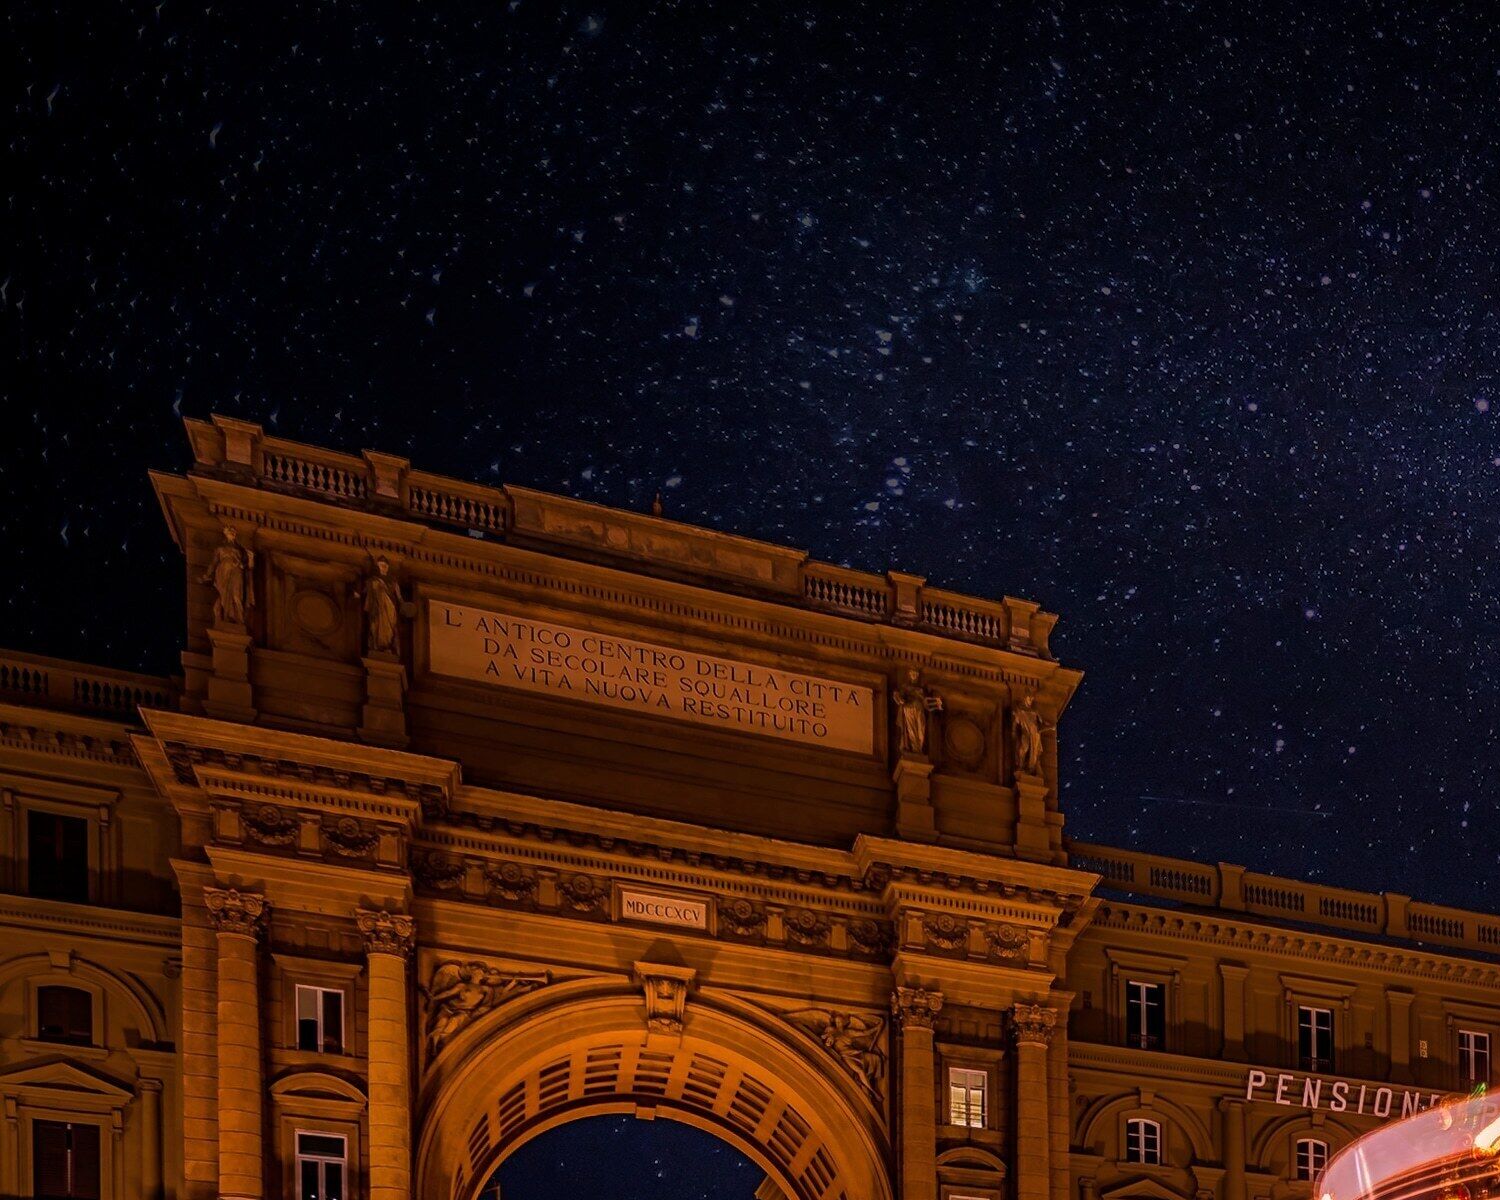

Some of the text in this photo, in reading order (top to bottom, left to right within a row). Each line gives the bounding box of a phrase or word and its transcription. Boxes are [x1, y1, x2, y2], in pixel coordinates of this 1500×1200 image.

[475, 616, 572, 649] ANTICO
[581, 637, 686, 672] CENTRO
[696, 659, 780, 691] DELLA
[483, 637, 827, 719] DA SECOLARE SQUALLORE
[485, 660, 828, 738] A VITA NUOVA RESTITUITO
[626, 899, 701, 923] MDCCCXCV
